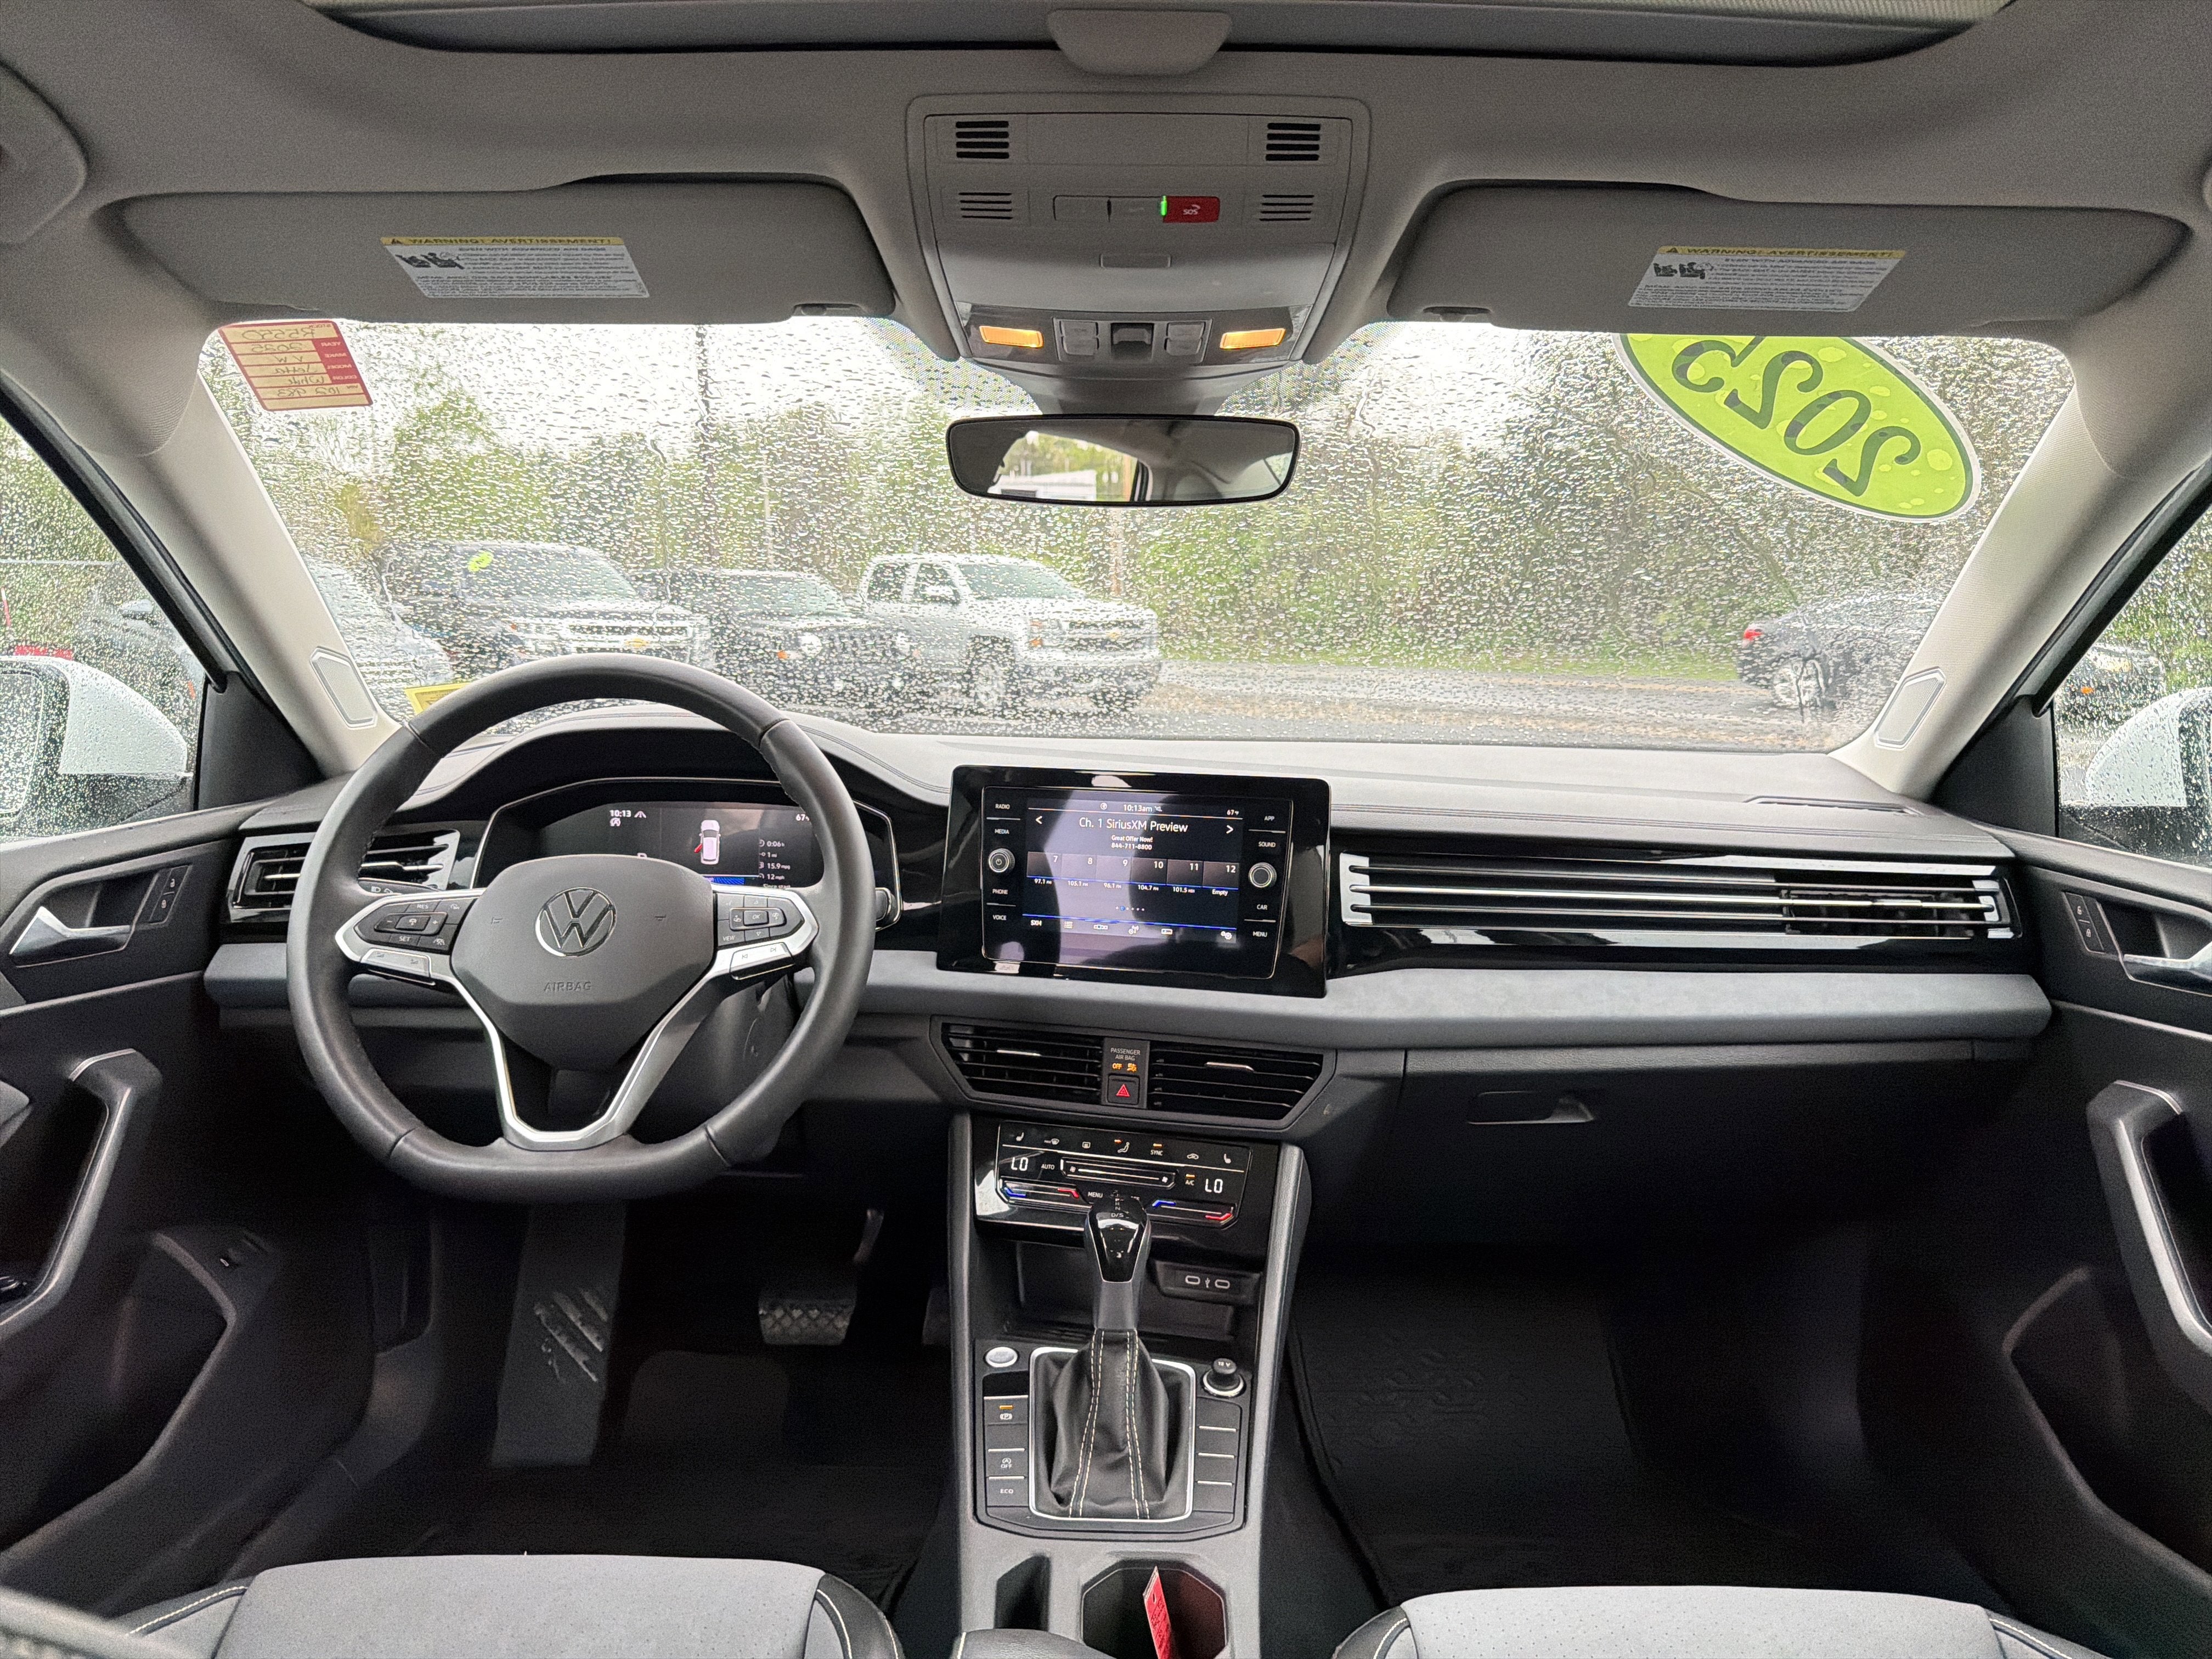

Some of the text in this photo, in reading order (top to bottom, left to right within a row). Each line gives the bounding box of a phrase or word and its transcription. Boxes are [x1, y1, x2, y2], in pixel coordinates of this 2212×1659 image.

[1079, 817, 1188, 833] Ch. 1 SiriusXM Preview
[543, 980, 591, 992] AIRBAG
[1110, 1047, 1141, 1056] PASSENGER
[1011, 1156, 1029, 1171] LO
[1205, 1178, 1223, 1194] LO
